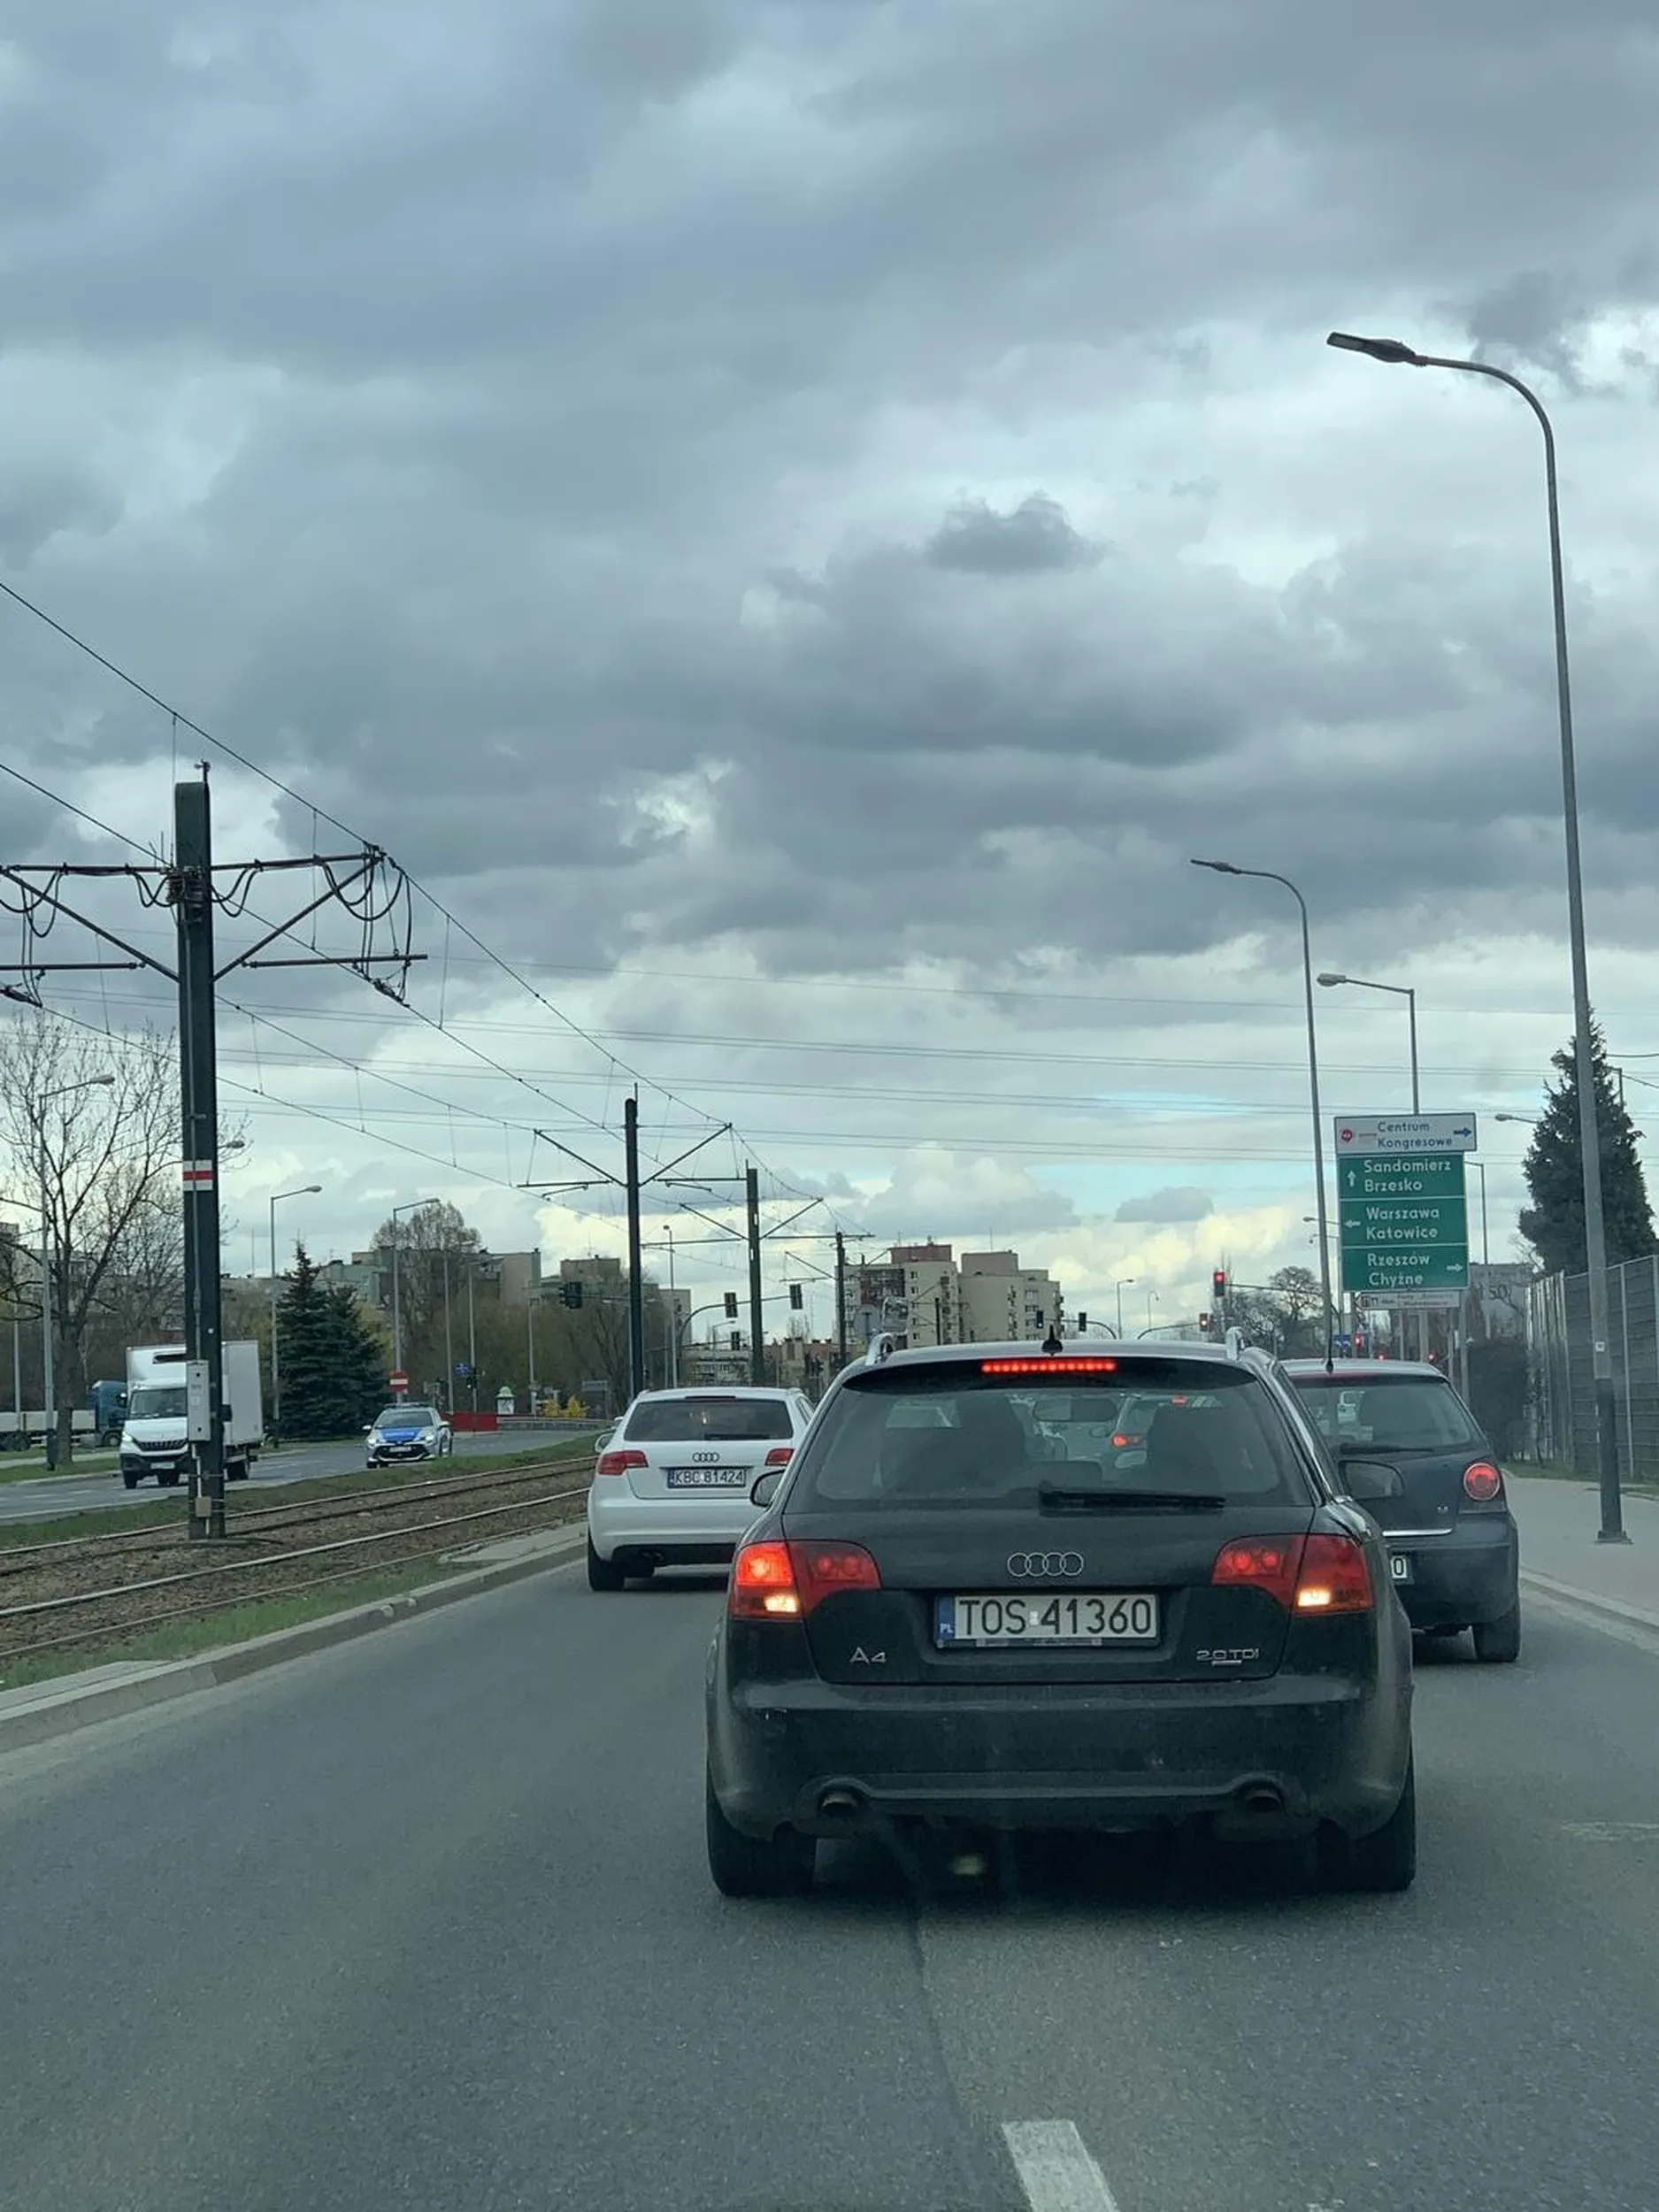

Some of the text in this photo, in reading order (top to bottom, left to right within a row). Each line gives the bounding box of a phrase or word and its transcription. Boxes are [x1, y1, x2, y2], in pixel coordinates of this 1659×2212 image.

[1377, 1121, 1430, 1133] Centrum
[1378, 1137, 1452, 1150] Kongresowe
[1363, 1159, 1451, 1173] Sandomierz
[1364, 1179, 1423, 1193] Brzesko
[1366, 1207, 1440, 1220] Warszawa
[1366, 1226, 1438, 1240] Katowice
[1368, 1252, 1430, 1267] Rzeszów
[1369, 1273, 1424, 1288] Chyżne
[675, 1469, 743, 1483] KBC 81424
[959, 1598, 1151, 1635] TOS 41360
[849, 1647, 887, 1664] A4
